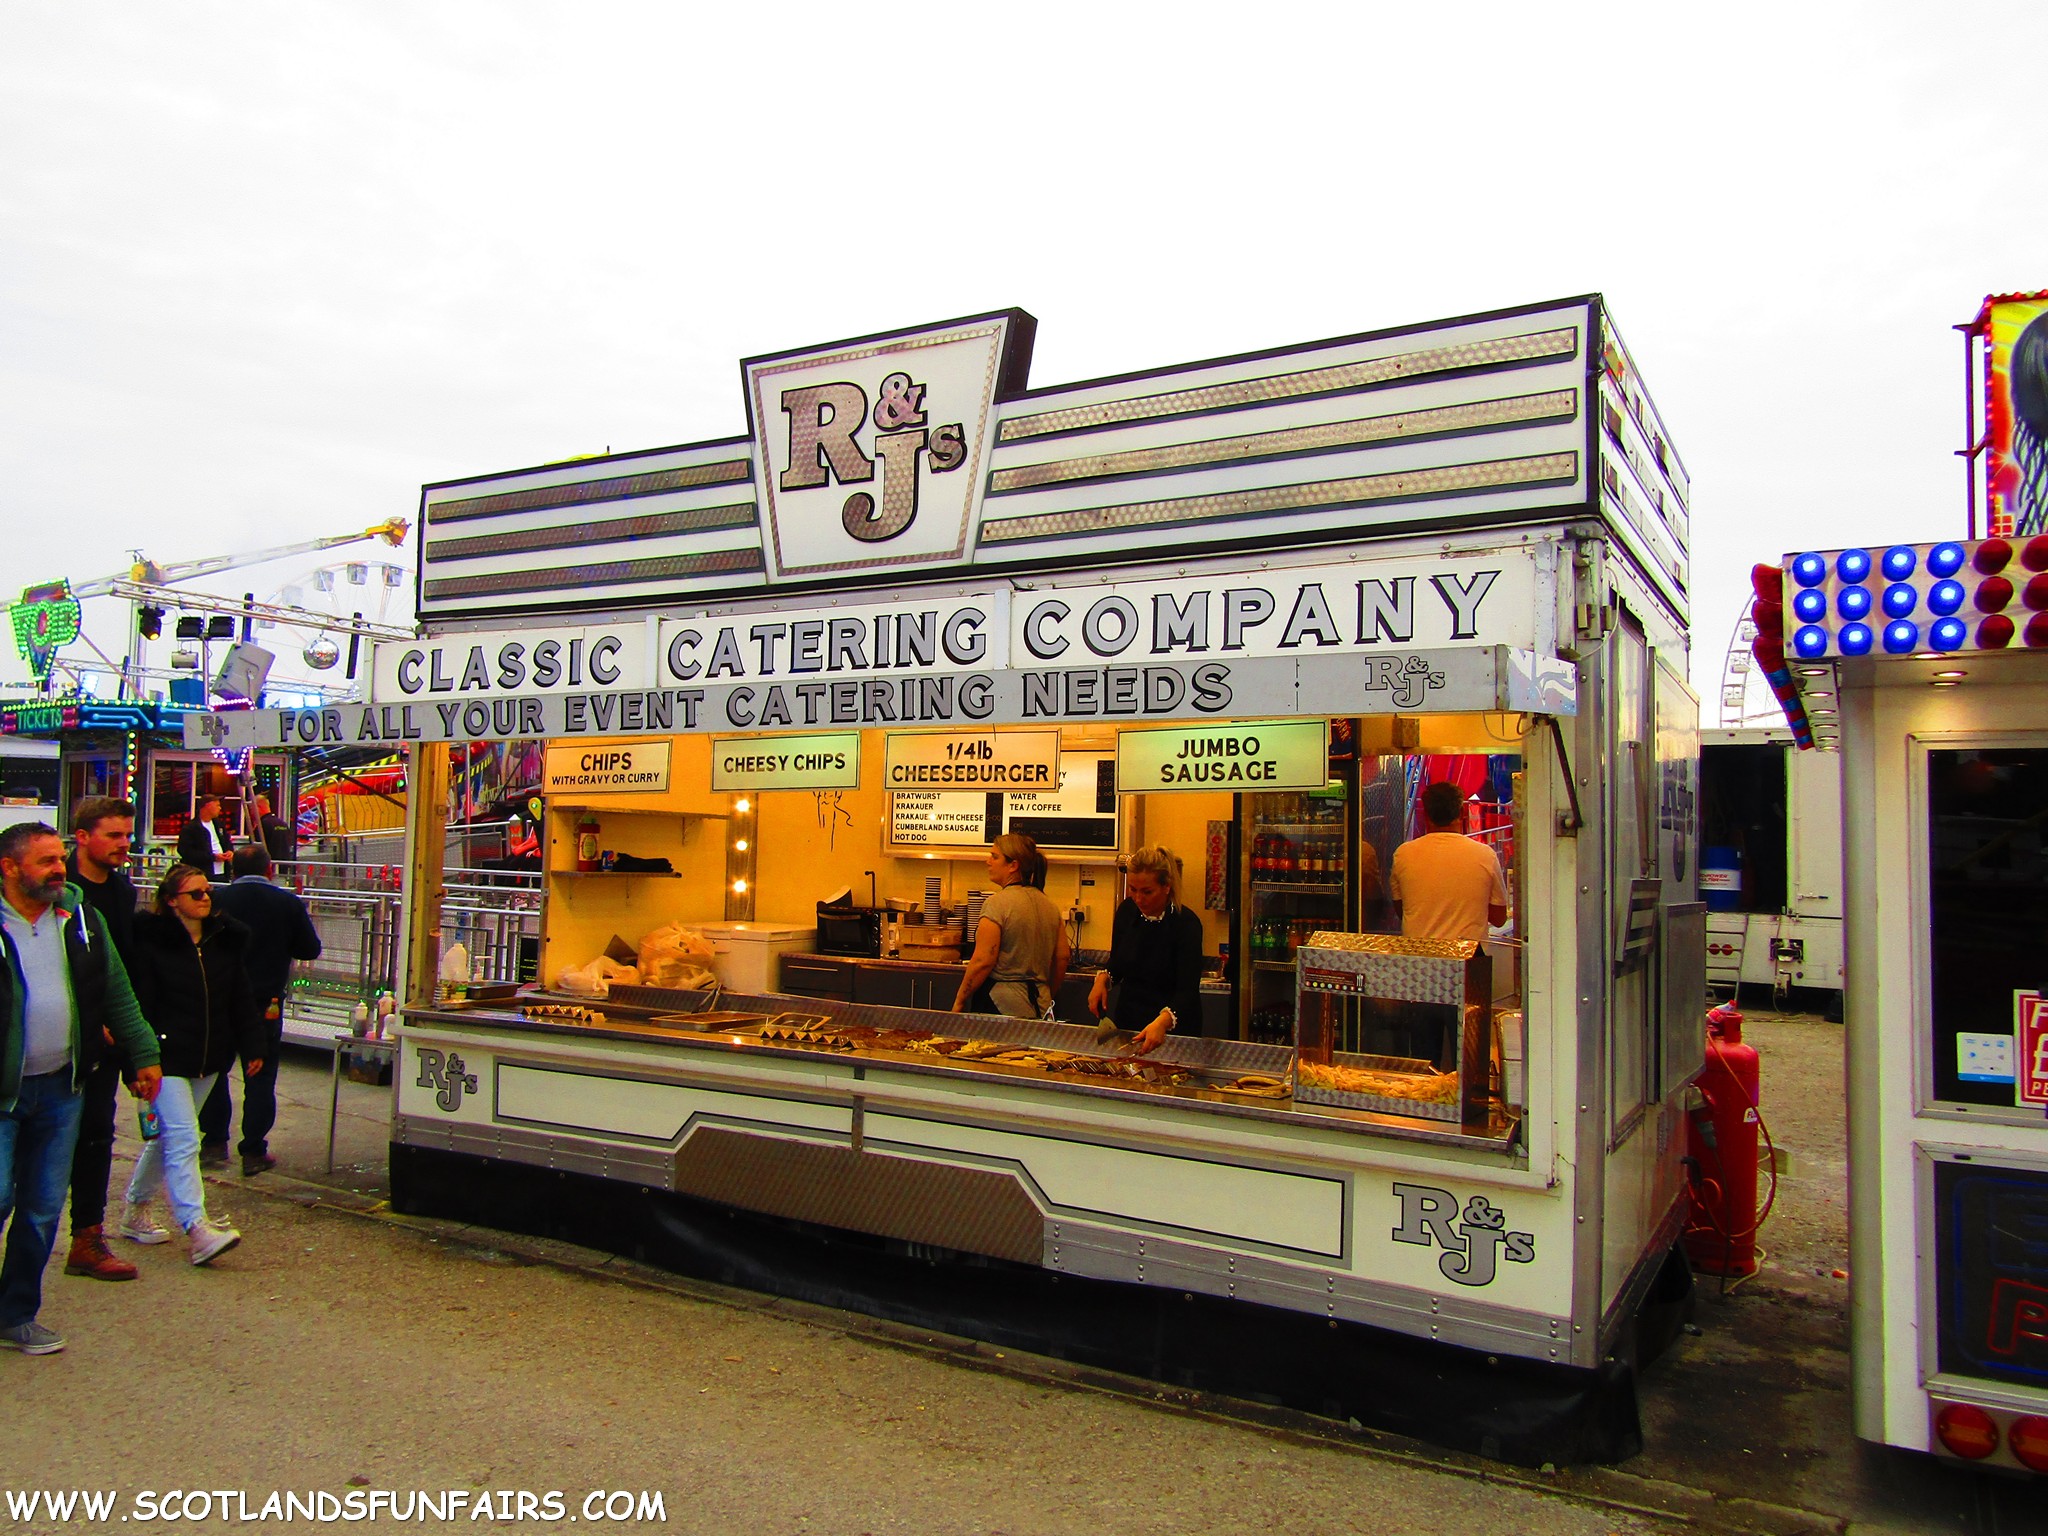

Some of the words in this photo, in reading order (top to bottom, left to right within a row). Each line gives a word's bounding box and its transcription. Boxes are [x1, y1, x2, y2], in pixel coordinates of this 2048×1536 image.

[398, 636, 622, 694] CLASSIC
[668, 607, 987, 680] CATERING
[1023, 570, 1502, 660] COMPANY
[279, 709, 343, 742] FOR
[358, 706, 421, 740] ALL
[437, 698, 545, 738] YOUR
[565, 690, 704, 733] EVENT
[726, 675, 995, 728] CATERING
[1021, 663, 1233, 717] NEEDS
[17, 708, 62, 730] TICKETS
[946, 740, 993, 760] 1/4lb
[1176, 736, 1261, 759] JUMBO
[580, 752, 633, 772] CHIPS
[723, 755, 790, 773] CHEESY
[793, 752, 846, 771] CHIPS
[1160, 761, 1277, 783] SAUSAGE
[551, 775, 576, 786] WITH
[577, 775, 610, 785] GRAVY
[612, 774, 625, 784] OR
[627, 772, 660, 783] CURRY
[891, 764, 1049, 782] CHEESEBURGER
[895, 813, 932, 821] KRAKAUE
[956, 814, 983, 822] CHEESE
[1009, 803, 1024, 811] TEA
[1031, 804, 1062, 812] COFFEE
[895, 823, 943, 831] CUMBERLAND
[944, 824, 979, 832] SAUSAGE
[895, 833, 910, 841] HOT
[911, 834, 927, 842] DOG
